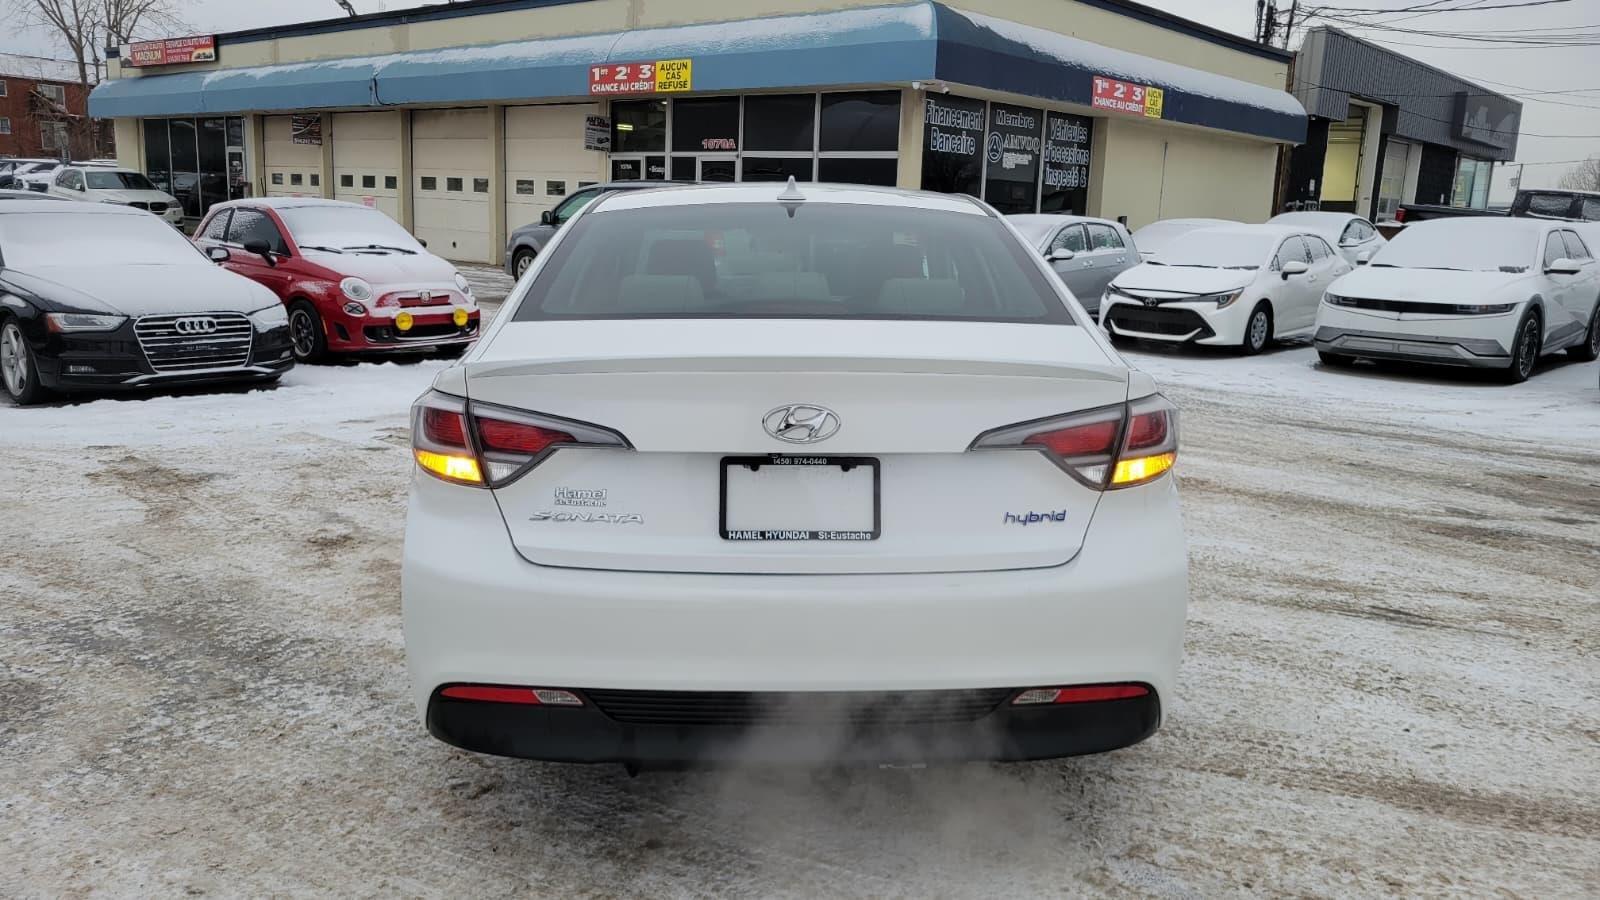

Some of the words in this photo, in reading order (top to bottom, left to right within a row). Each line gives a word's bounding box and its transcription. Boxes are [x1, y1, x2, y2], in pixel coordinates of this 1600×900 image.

[660, 61, 688, 71] AUCUN
[665, 71, 681, 80] CAS
[591, 82, 618, 92] CHANCE
[620, 82, 629, 91] AU
[630, 80, 654, 91] CRÉDIT
[658, 78, 688, 90] REFUSÉ
[1094, 96, 1117, 109] CHANCE
[1117, 101, 1125, 110] AU
[924, 98, 985, 131] Financement
[995, 109, 1035, 129] Membre
[1050, 117, 1088, 143] Véhicules
[930, 126, 976, 156] Bancaire
[1044, 140, 1090, 165] d'occasions
[1045, 166, 1079, 190] inspecté
[1080, 168, 1087, 188] &
[793, 457, 828, 465] 974-0440
[554, 486, 608, 500] Hamel
[529, 511, 645, 525] SONATA
[1003, 509, 1067, 526] hybrid
[728, 530, 763, 540] HAMEL
[765, 530, 809, 540] HYUNDAI
[817, 530, 872, 540] St-Eustache
